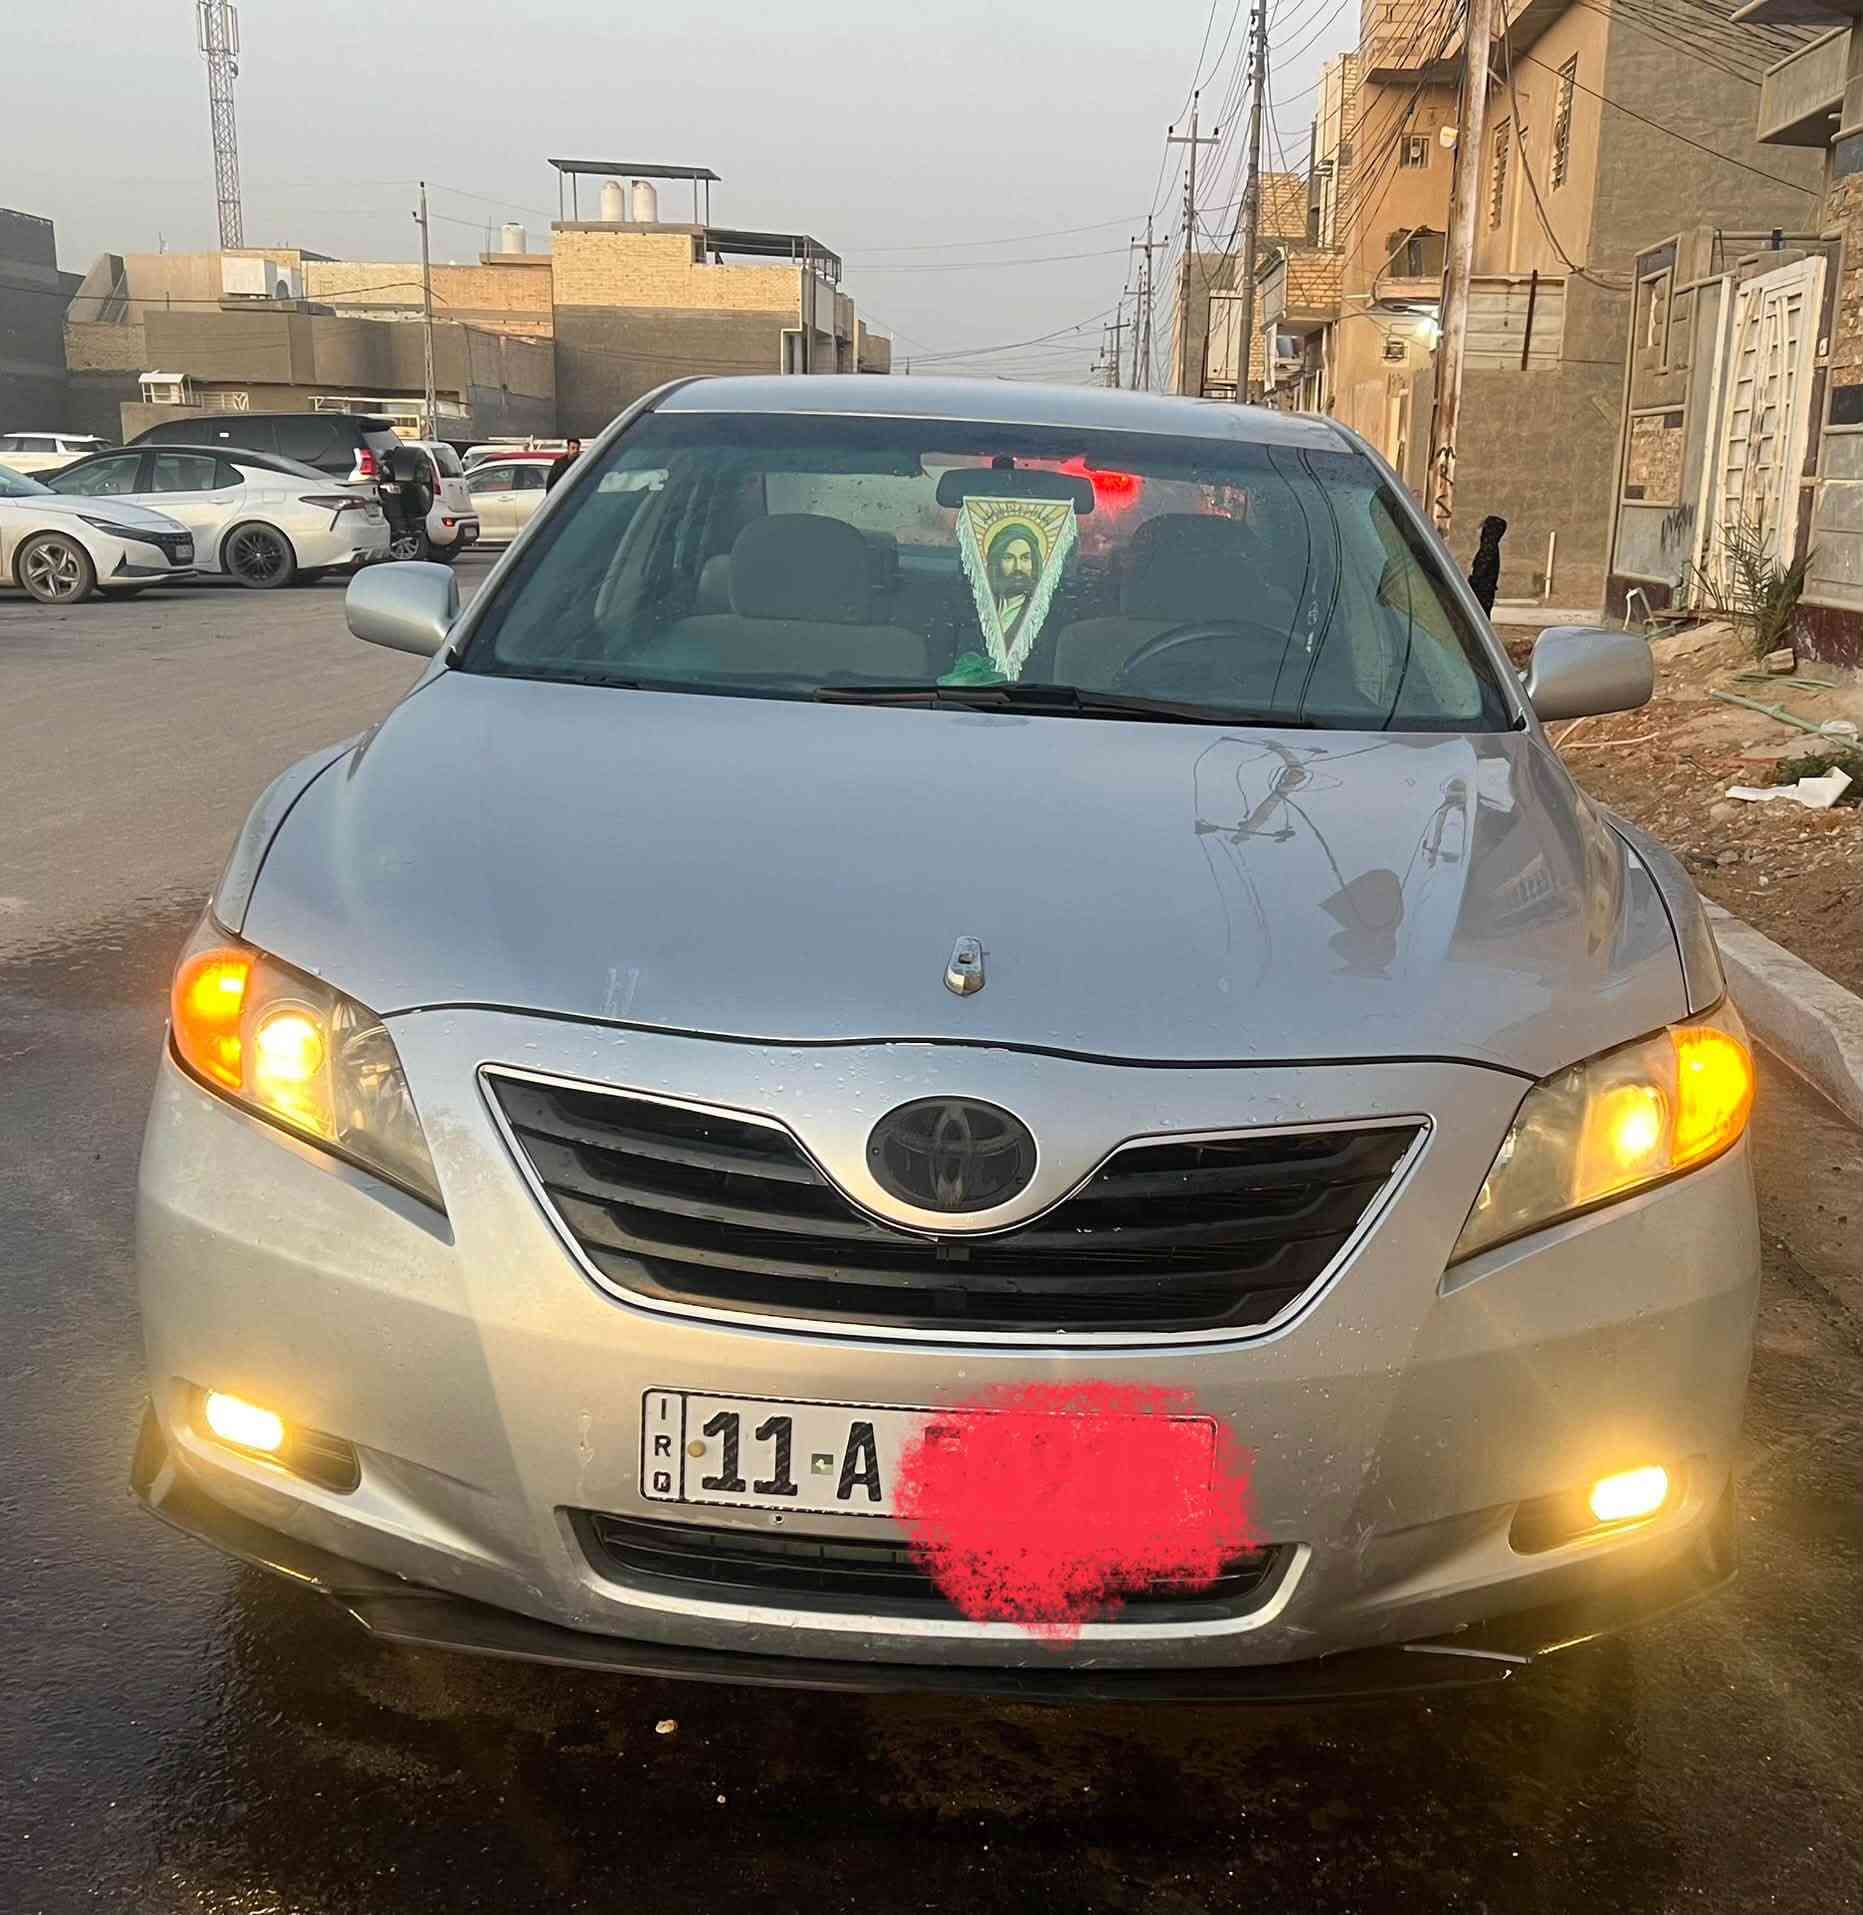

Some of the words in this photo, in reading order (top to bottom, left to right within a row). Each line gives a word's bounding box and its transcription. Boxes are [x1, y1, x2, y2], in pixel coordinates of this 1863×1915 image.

[653, 1397, 672, 1493] IRQ
[702, 1411, 798, 1496] 11
[836, 1421, 882, 1502] A
